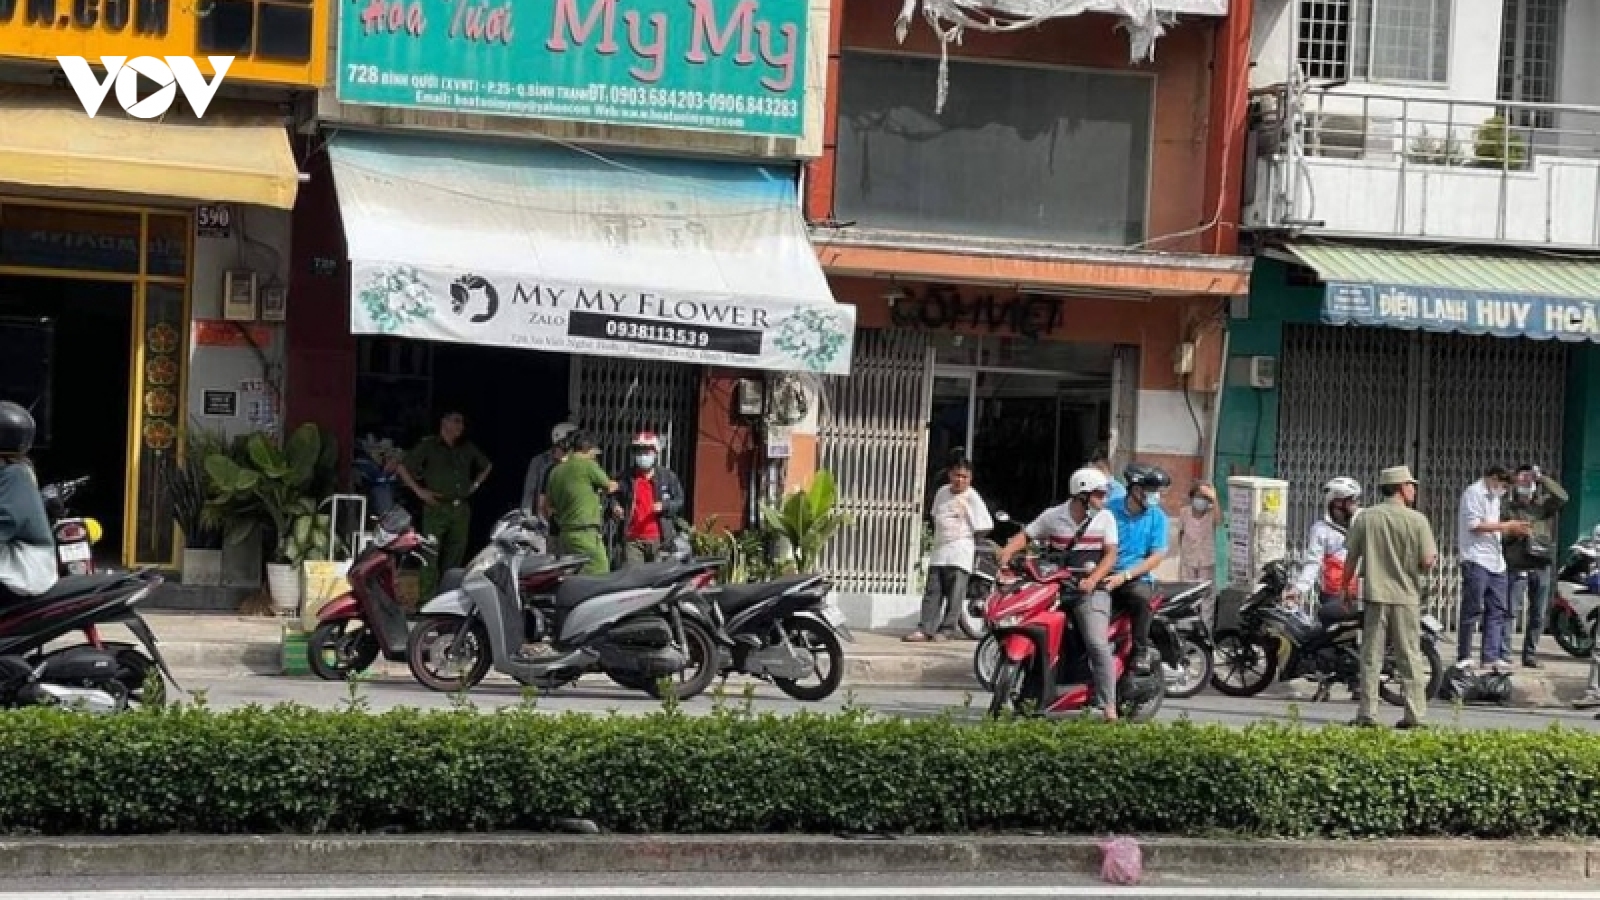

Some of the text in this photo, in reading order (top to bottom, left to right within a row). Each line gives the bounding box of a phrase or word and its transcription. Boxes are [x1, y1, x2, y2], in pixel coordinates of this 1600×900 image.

[546, 0, 667, 83] My
[684, 0, 797, 92] My
[348, 63, 379, 84] 728
[511, 281, 771, 329] MY MY FLOWER
[529, 311, 565, 327] ZALO
[1475, 299, 1533, 329] HUY
[605, 319, 709, 348] 0938113539
